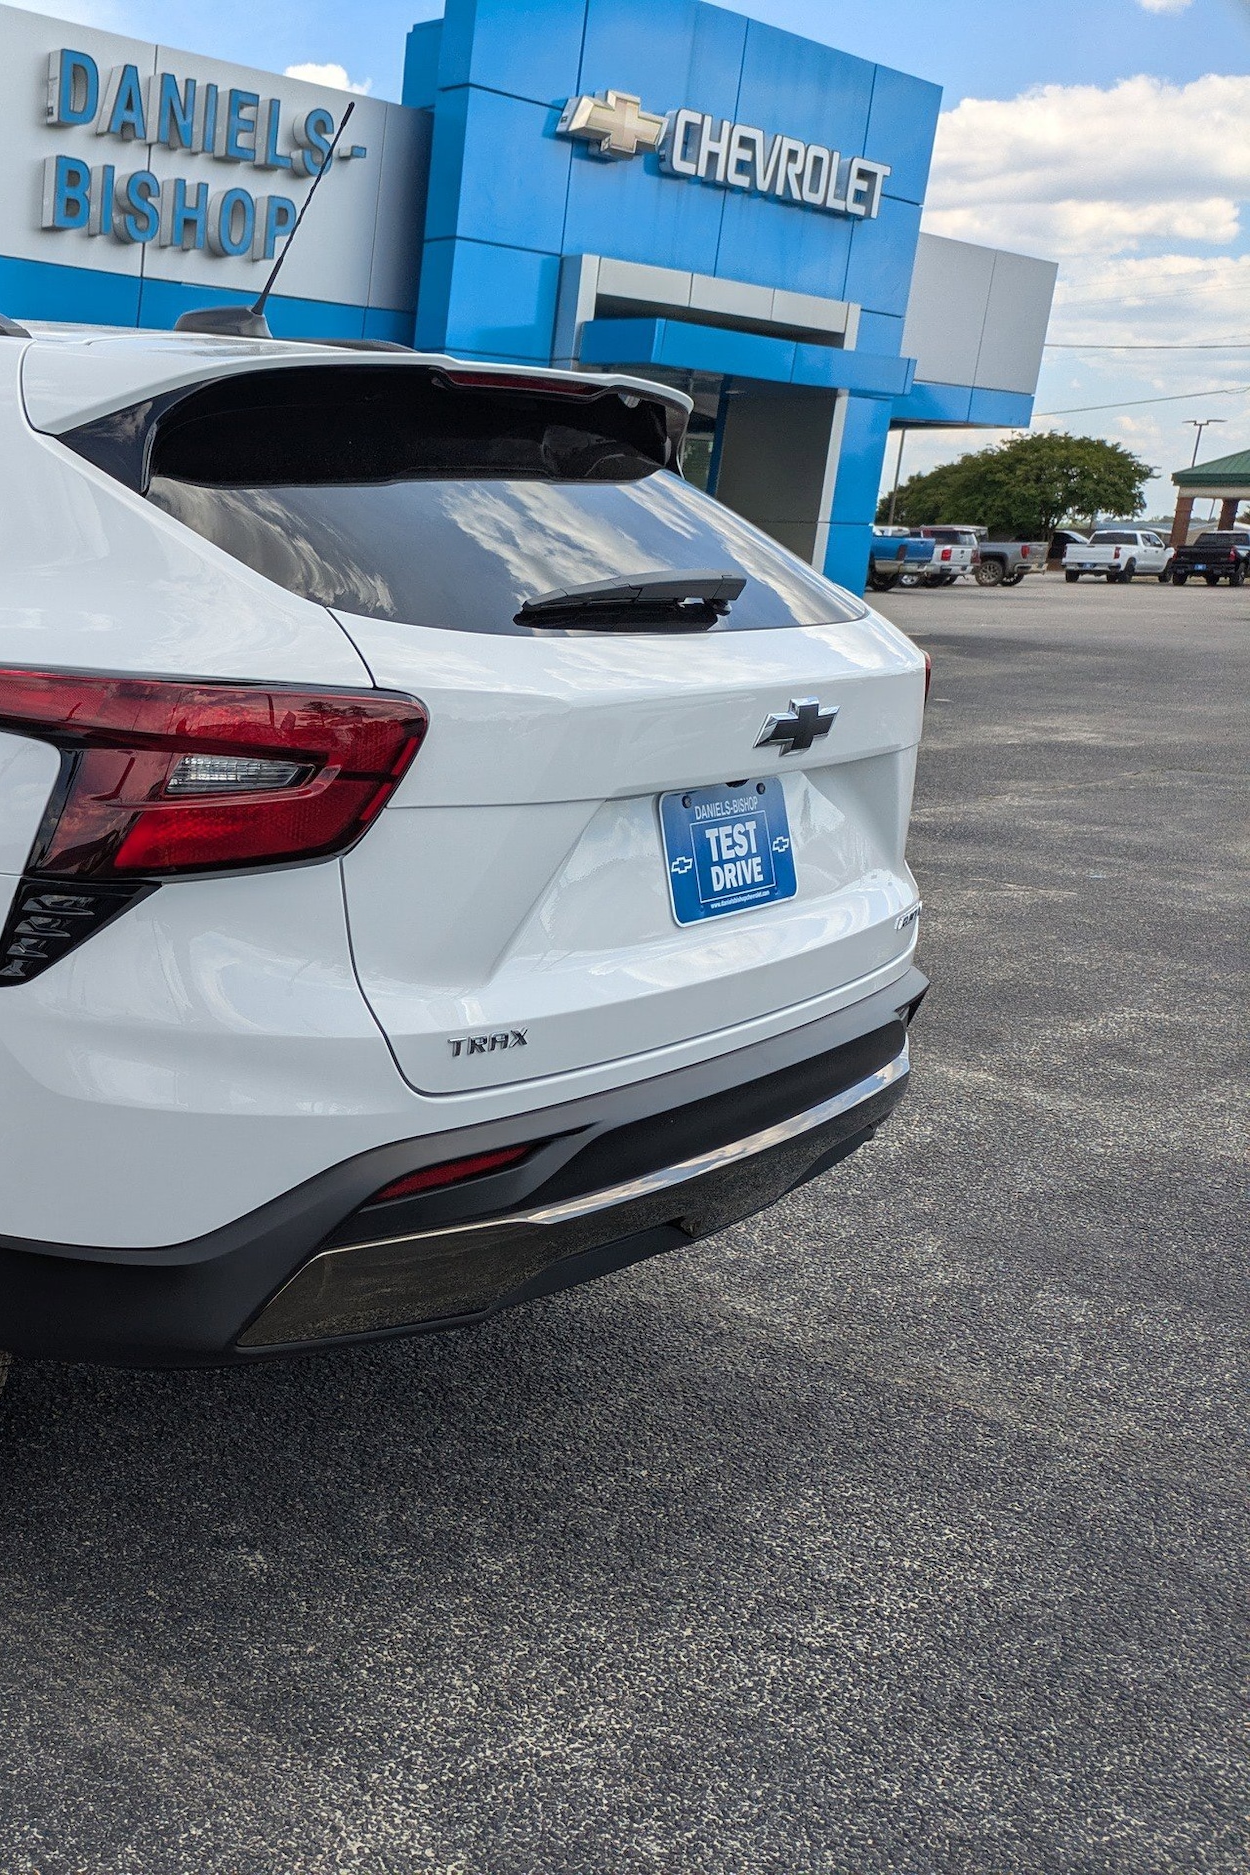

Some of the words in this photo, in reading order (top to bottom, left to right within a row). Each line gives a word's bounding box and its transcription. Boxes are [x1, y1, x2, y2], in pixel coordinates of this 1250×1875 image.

[663, 107, 892, 220] CHEVROLET
[43, 154, 297, 262] BISHOP
[694, 795, 759, 821] DANIELS-BISHOP
[705, 820, 758, 862] TEST
[710, 856, 764, 893] DRIVE
[447, 1026, 529, 1057] TRAX
